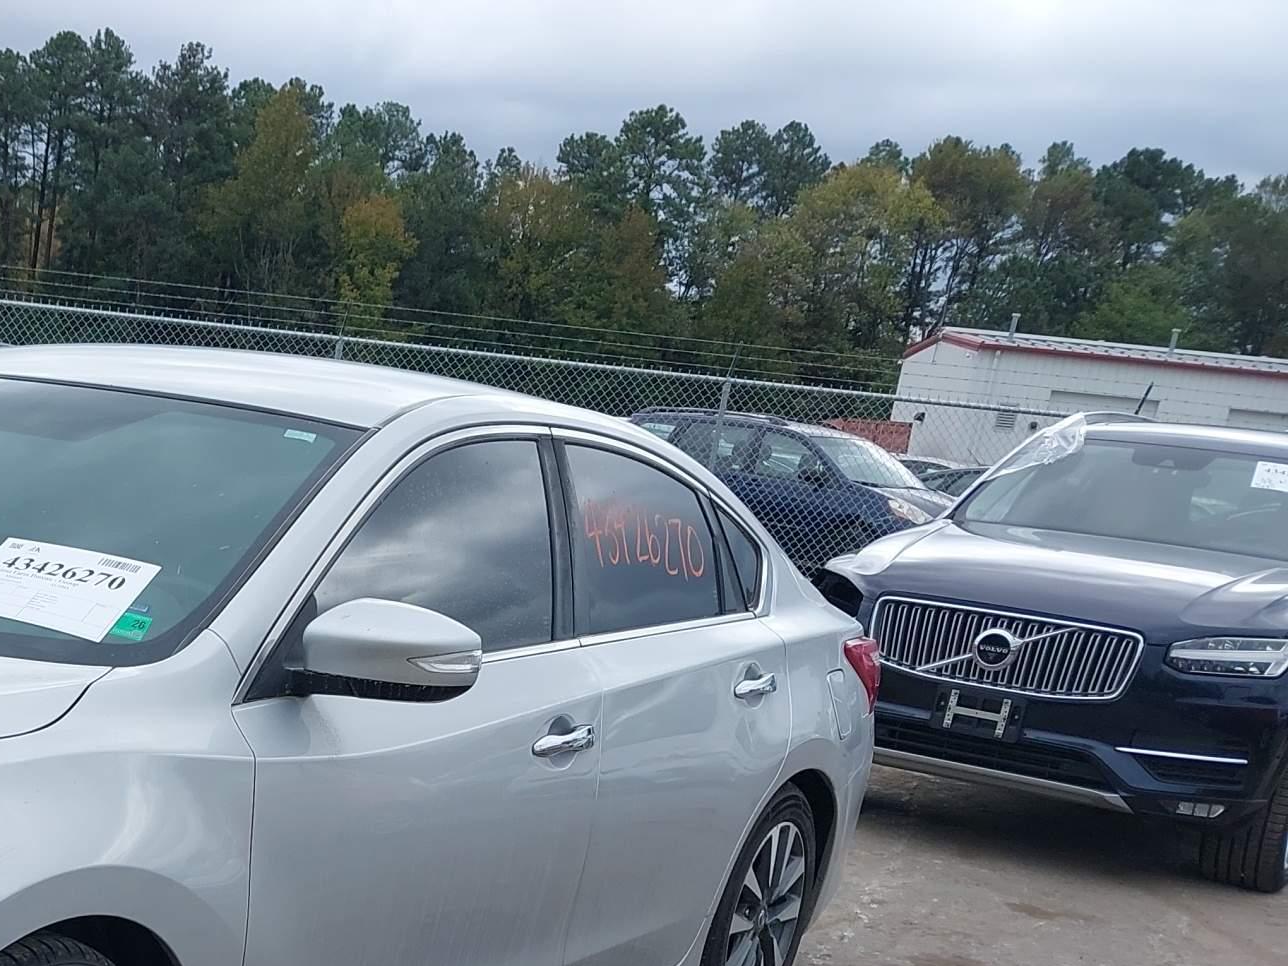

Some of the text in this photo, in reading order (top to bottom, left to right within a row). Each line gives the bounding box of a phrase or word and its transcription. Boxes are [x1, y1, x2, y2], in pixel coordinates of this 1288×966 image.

[2, 556, 126, 590] 43426270
[131, 618, 147, 630] 26
[979, 644, 1009, 654] VOLVO
